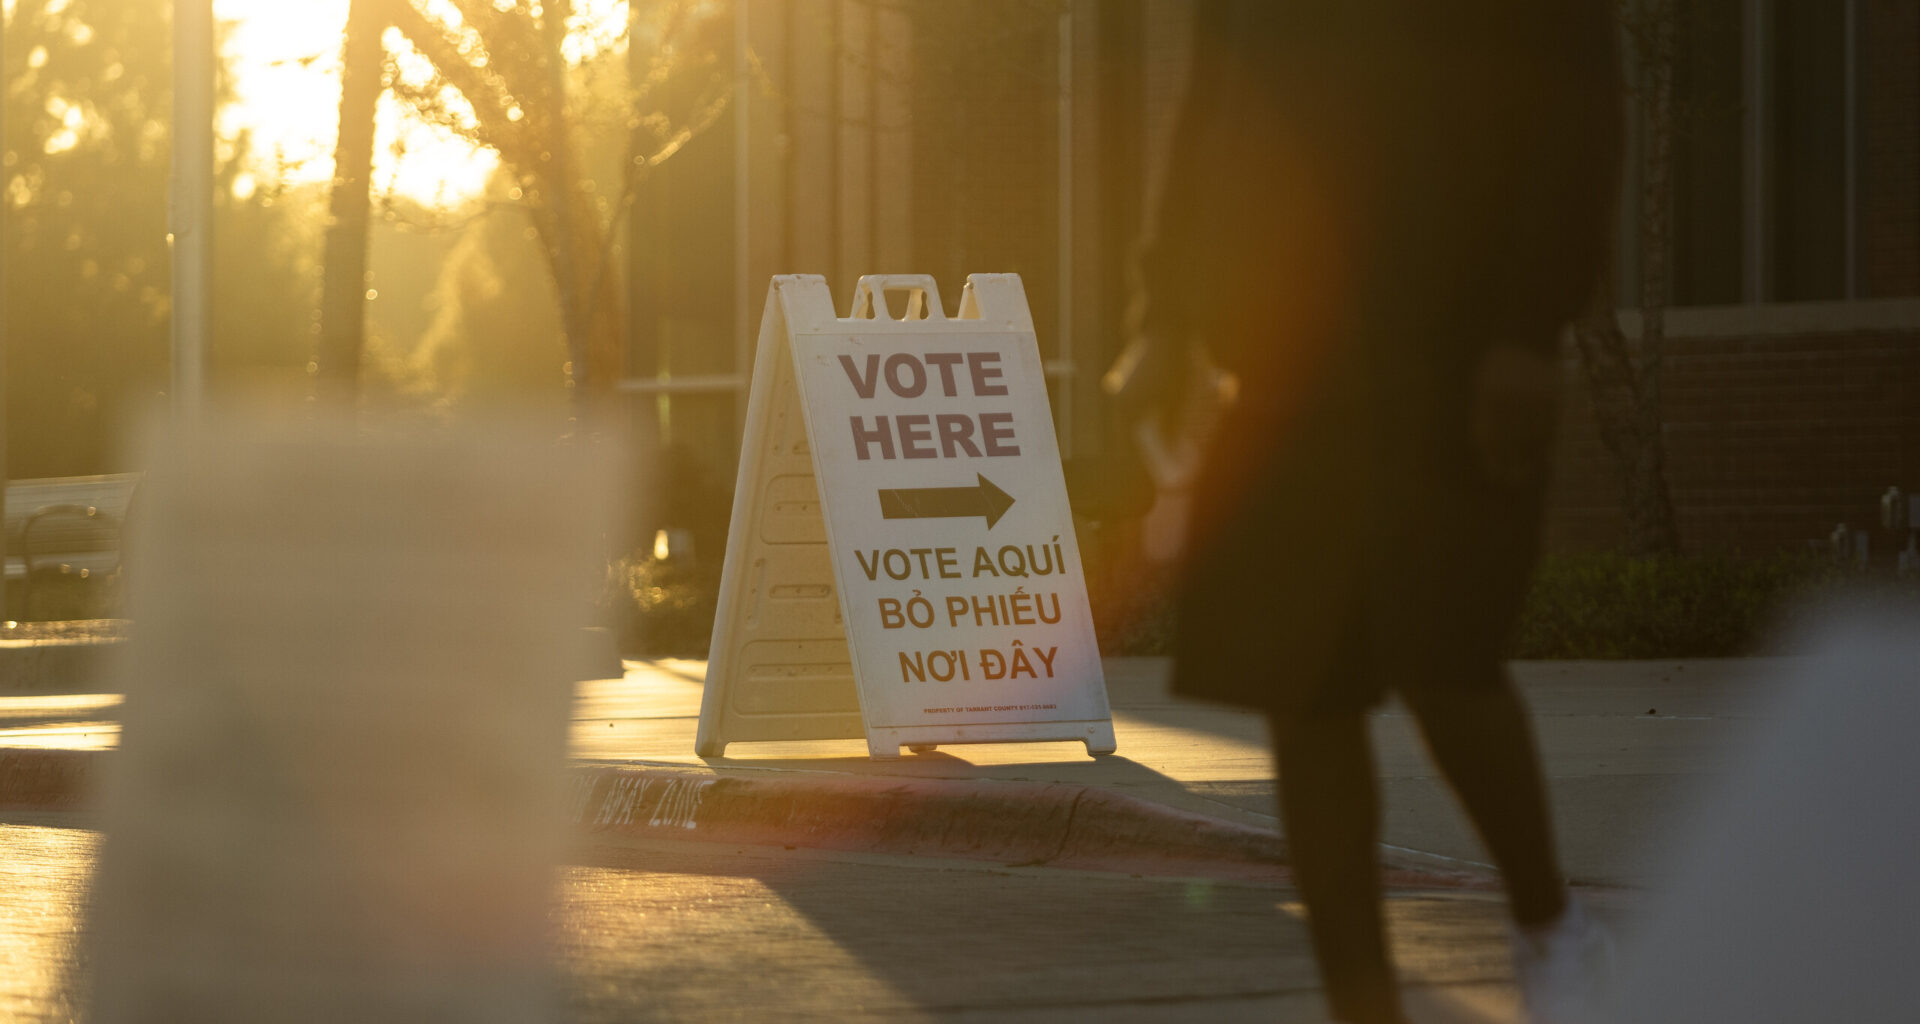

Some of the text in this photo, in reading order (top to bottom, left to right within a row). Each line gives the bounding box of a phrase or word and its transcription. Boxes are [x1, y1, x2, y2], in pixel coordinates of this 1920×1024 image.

[838, 352, 1009, 399] VOTE
[850, 412, 1021, 460] HERE
[854, 535, 1067, 581] VOTE AQUÍ
[878, 586, 1062, 629] BỎ PHIẾU
[898, 639, 1058, 683] NƠI ĐÂY
[648, 777, 716, 829] ZONE
